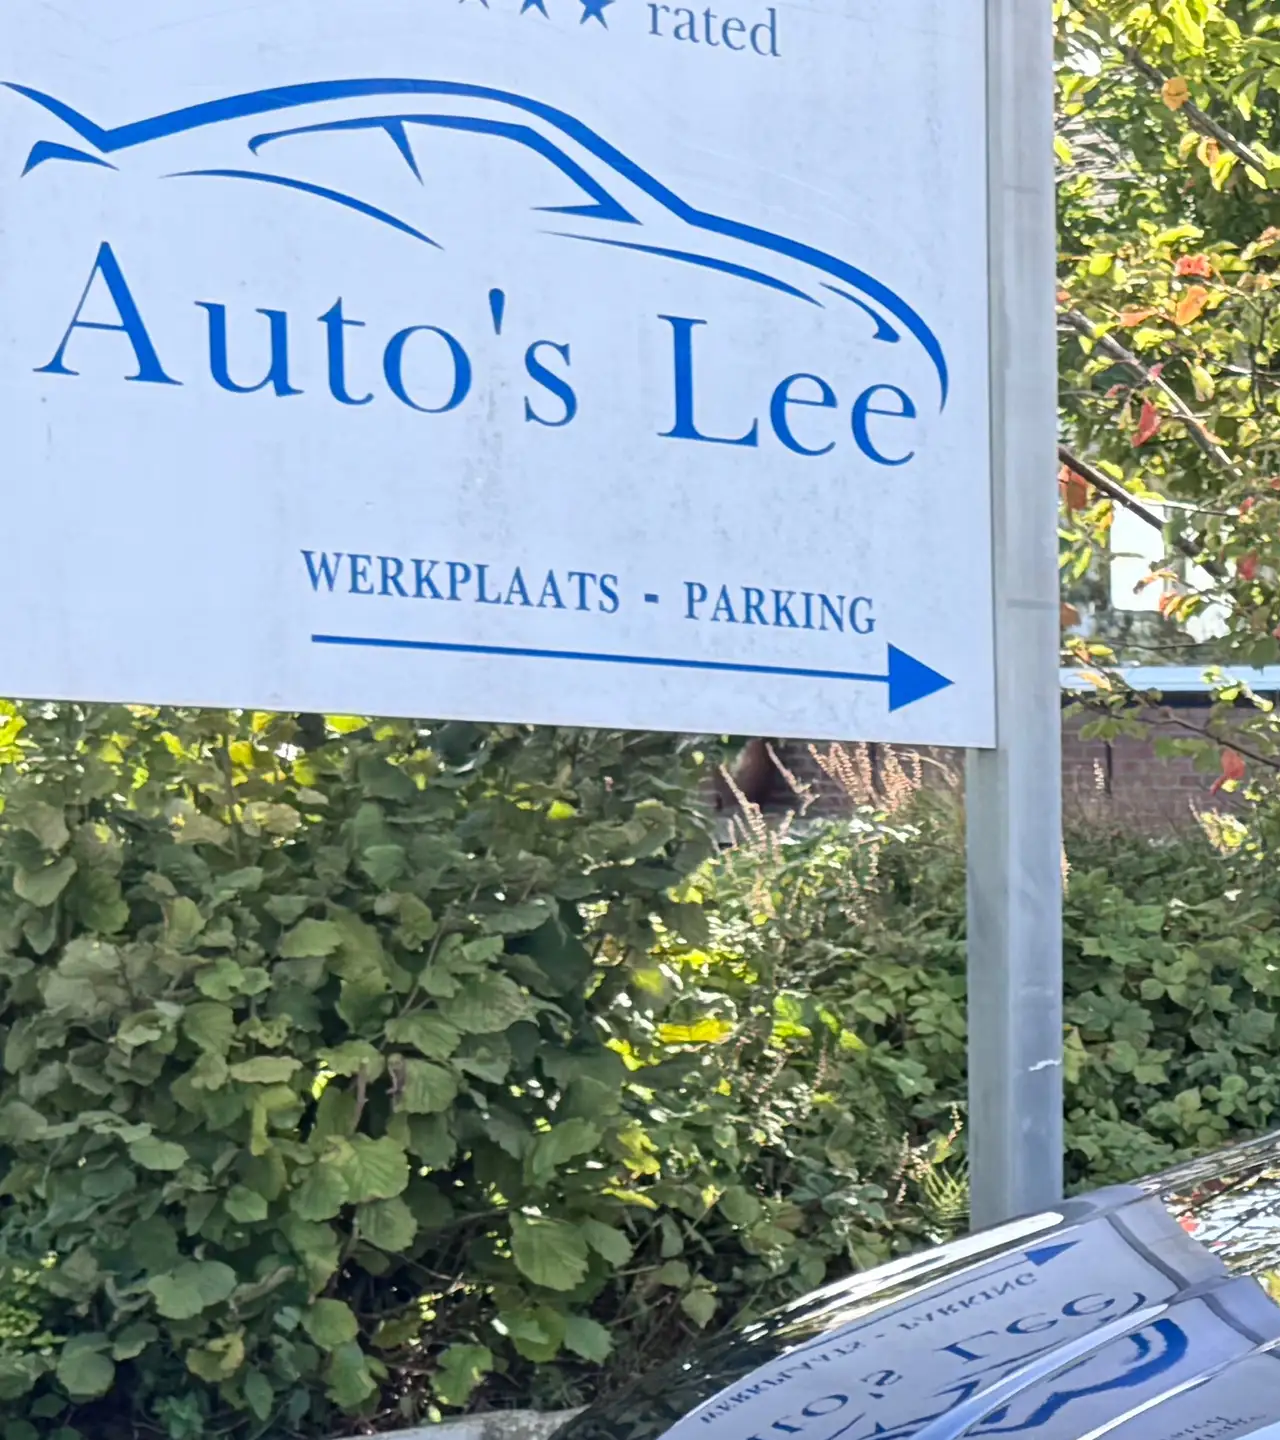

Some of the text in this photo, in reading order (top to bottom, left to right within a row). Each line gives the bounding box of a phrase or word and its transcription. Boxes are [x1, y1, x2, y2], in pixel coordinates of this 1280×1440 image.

[646, 2, 782, 58] rated
[33, 241, 917, 466] Auto's Lee
[300, 549, 621, 614] WERKPLAATS
[683, 580, 877, 635] PARKING
